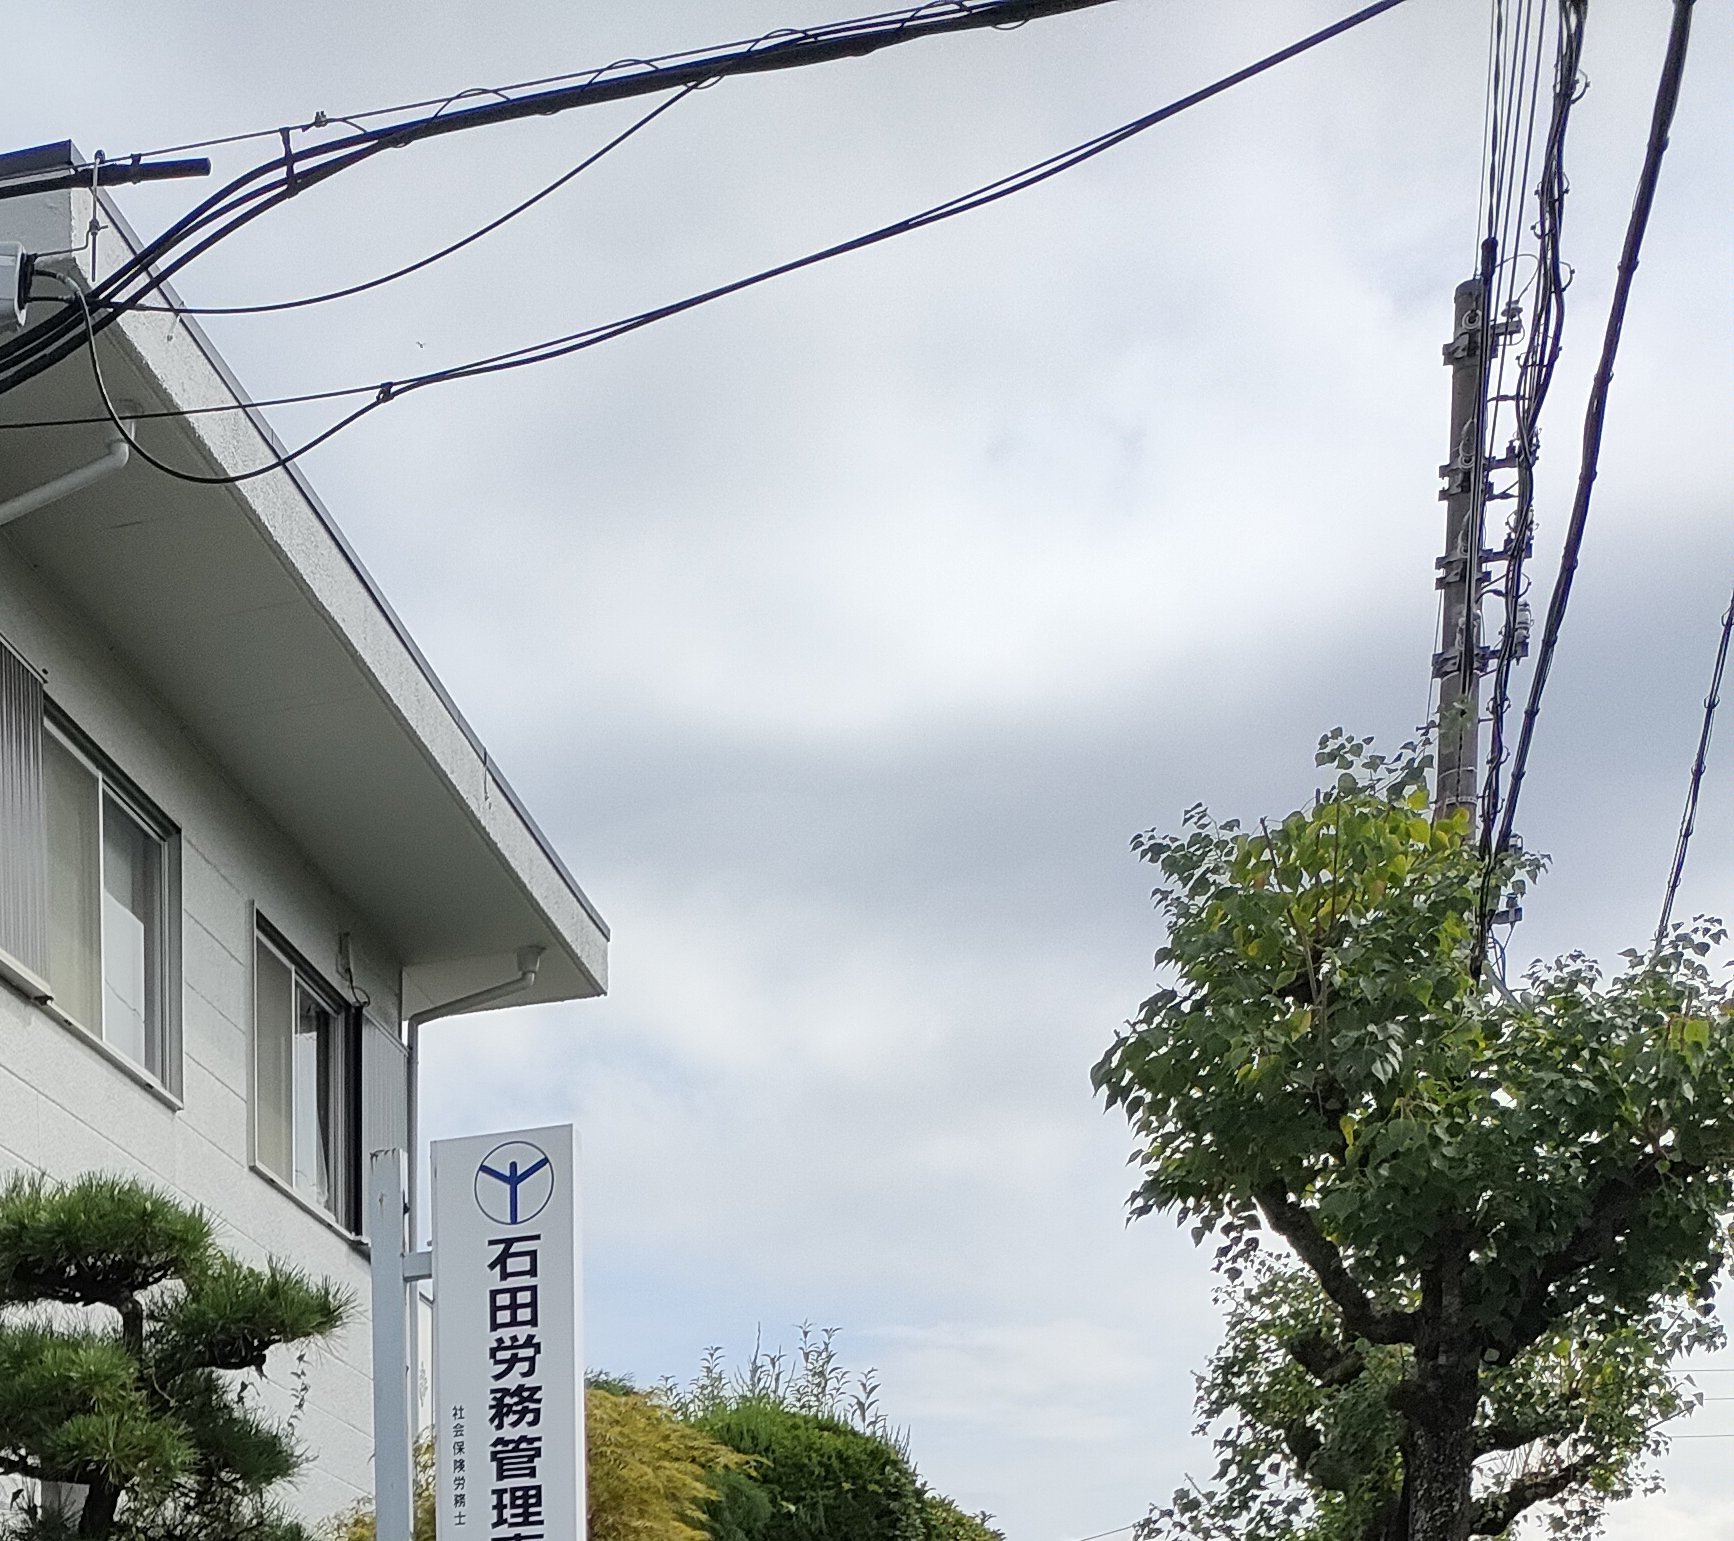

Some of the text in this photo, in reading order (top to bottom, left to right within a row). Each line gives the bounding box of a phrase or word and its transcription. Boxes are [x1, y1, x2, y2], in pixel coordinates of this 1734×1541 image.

[452, 1404, 467, 1527] 社会保険労務士
